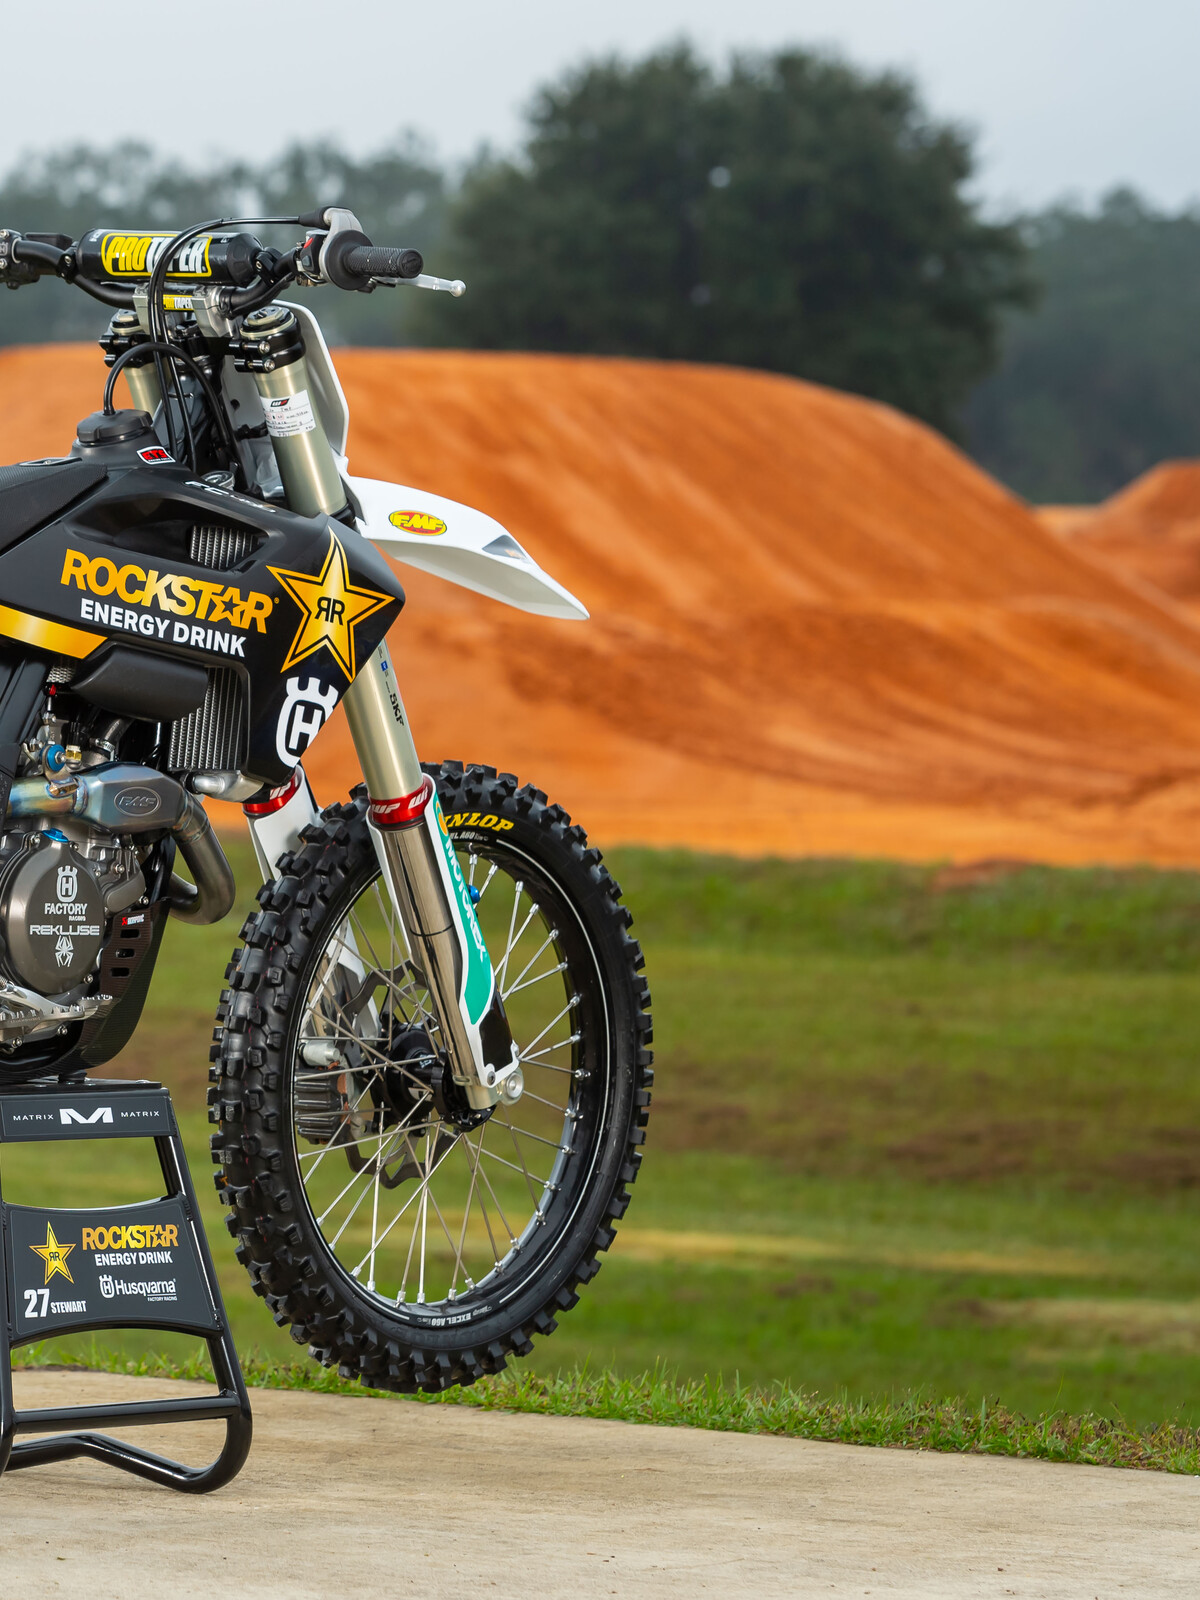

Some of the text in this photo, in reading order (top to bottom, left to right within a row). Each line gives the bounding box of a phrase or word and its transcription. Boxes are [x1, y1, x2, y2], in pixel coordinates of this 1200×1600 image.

[141, 449, 168, 460] ETS
[391, 513, 444, 531] FMF
[60, 548, 273, 634] ROCKSTAR
[80, 597, 247, 658] ENERGY DRINK
[390, 692, 404, 726] SKF
[444, 812, 514, 832] NLOP
[44, 903, 88, 915] FACTORY
[445, 840, 486, 962] MOTOREX
[29, 925, 100, 936] REKLUSE
[13, 1114, 54, 1122] MATRIX
[120, 1110, 160, 1118] MATRIX
[82, 1224, 179, 1251] ROCKSTAR
[94, 1251, 173, 1267] ENERGY DRINK
[116, 1279, 176, 1297] Husqvarna
[23, 1288, 87, 1318] 27 STEWART
[446, 1312, 472, 1324] EXCEL
